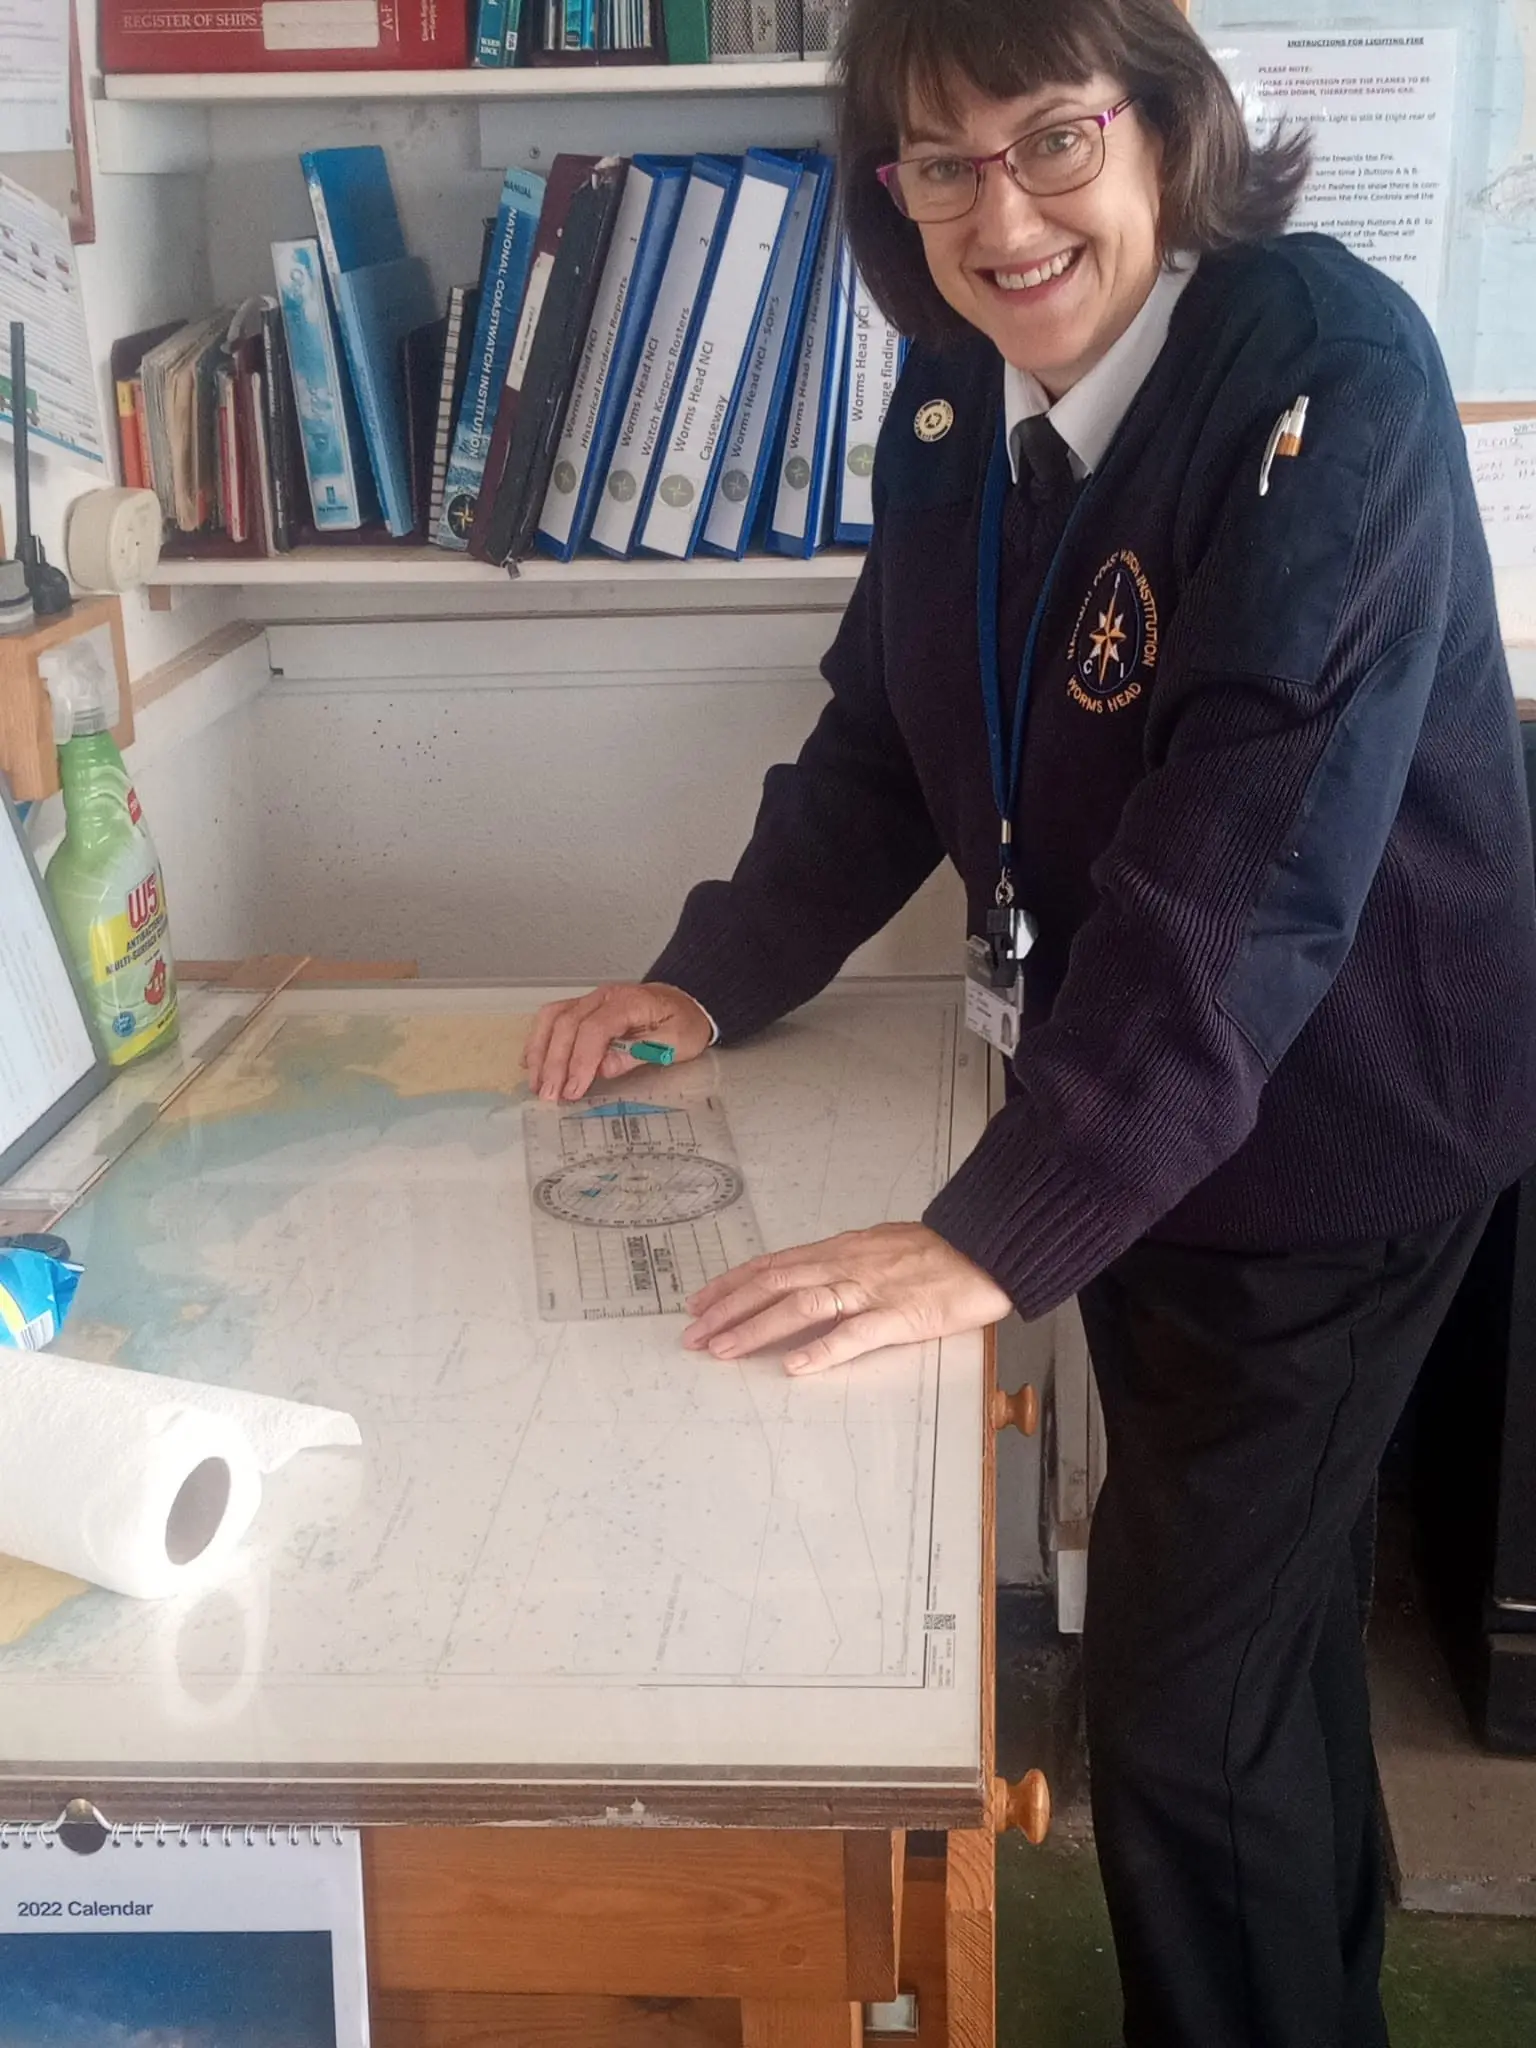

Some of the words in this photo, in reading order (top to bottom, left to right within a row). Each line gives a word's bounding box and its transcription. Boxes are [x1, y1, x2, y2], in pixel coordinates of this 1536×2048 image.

[123, 14, 192, 28] REGISTER
[194, 14, 213, 27] OF
[216, 13, 258, 27] SHIPS
[1287, 38, 1346, 48] INSTRUCTIONS
[1348, 38, 1364, 47] FOR
[1365, 37, 1405, 47] LIGHTING
[1406, 37, 1424, 46] FIRE
[1295, 78, 1340, 86] PROVISION
[1341, 77, 1357, 85] FOR
[1320, 88, 1363, 96] THEREFORE
[1366, 87, 1395, 95] SAVING
[1365, 154, 1378, 162] the
[1404, 192, 1419, 200] and
[1421, 192, 1434, 200] the
[496, 206, 518, 278] NATIONAL
[700, 236, 709, 247] 2
[759, 242, 770, 251] 3
[482, 276, 507, 376] COASTWATCH
[857, 305, 871, 330] NCI
[581, 387, 601, 449] Historical
[597, 331, 614, 386] Incident
[610, 276, 629, 331] Reports
[804, 333, 815, 359] NCI
[856, 333, 868, 369] Head
[880, 329, 897, 380] finding
[566, 391, 583, 439] Worms
[578, 353, 594, 390] Head
[587, 329, 599, 352] NCI
[621, 401, 642, 448] Worms
[635, 363, 652, 399] Head
[646, 337, 660, 362] NCI
[641, 410, 660, 457] Watch
[654, 360, 675, 409] Keepers
[668, 307, 690, 358] Rosters
[674, 406, 696, 452] Worms
[689, 366, 708, 403] Head
[701, 341, 715, 364] NCI
[800, 363, 812, 398] Head
[852, 373, 866, 422] Worms
[469, 374, 491, 460] INSTITUTION
[731, 414, 751, 458] Worms
[745, 374, 761, 411] Head
[754, 347, 769, 371] NCI
[699, 394, 730, 461] Causeway
[790, 405, 806, 450] Worms
[1135, 574, 1158, 667] INSTITUTION
[1083, 660, 1093, 675] C
[1106, 682, 1142, 713] HEAD
[127, 872, 158, 932] W5
[17, 1901, 63, 1918] 2022
[68, 1900, 154, 1917] Calendar
